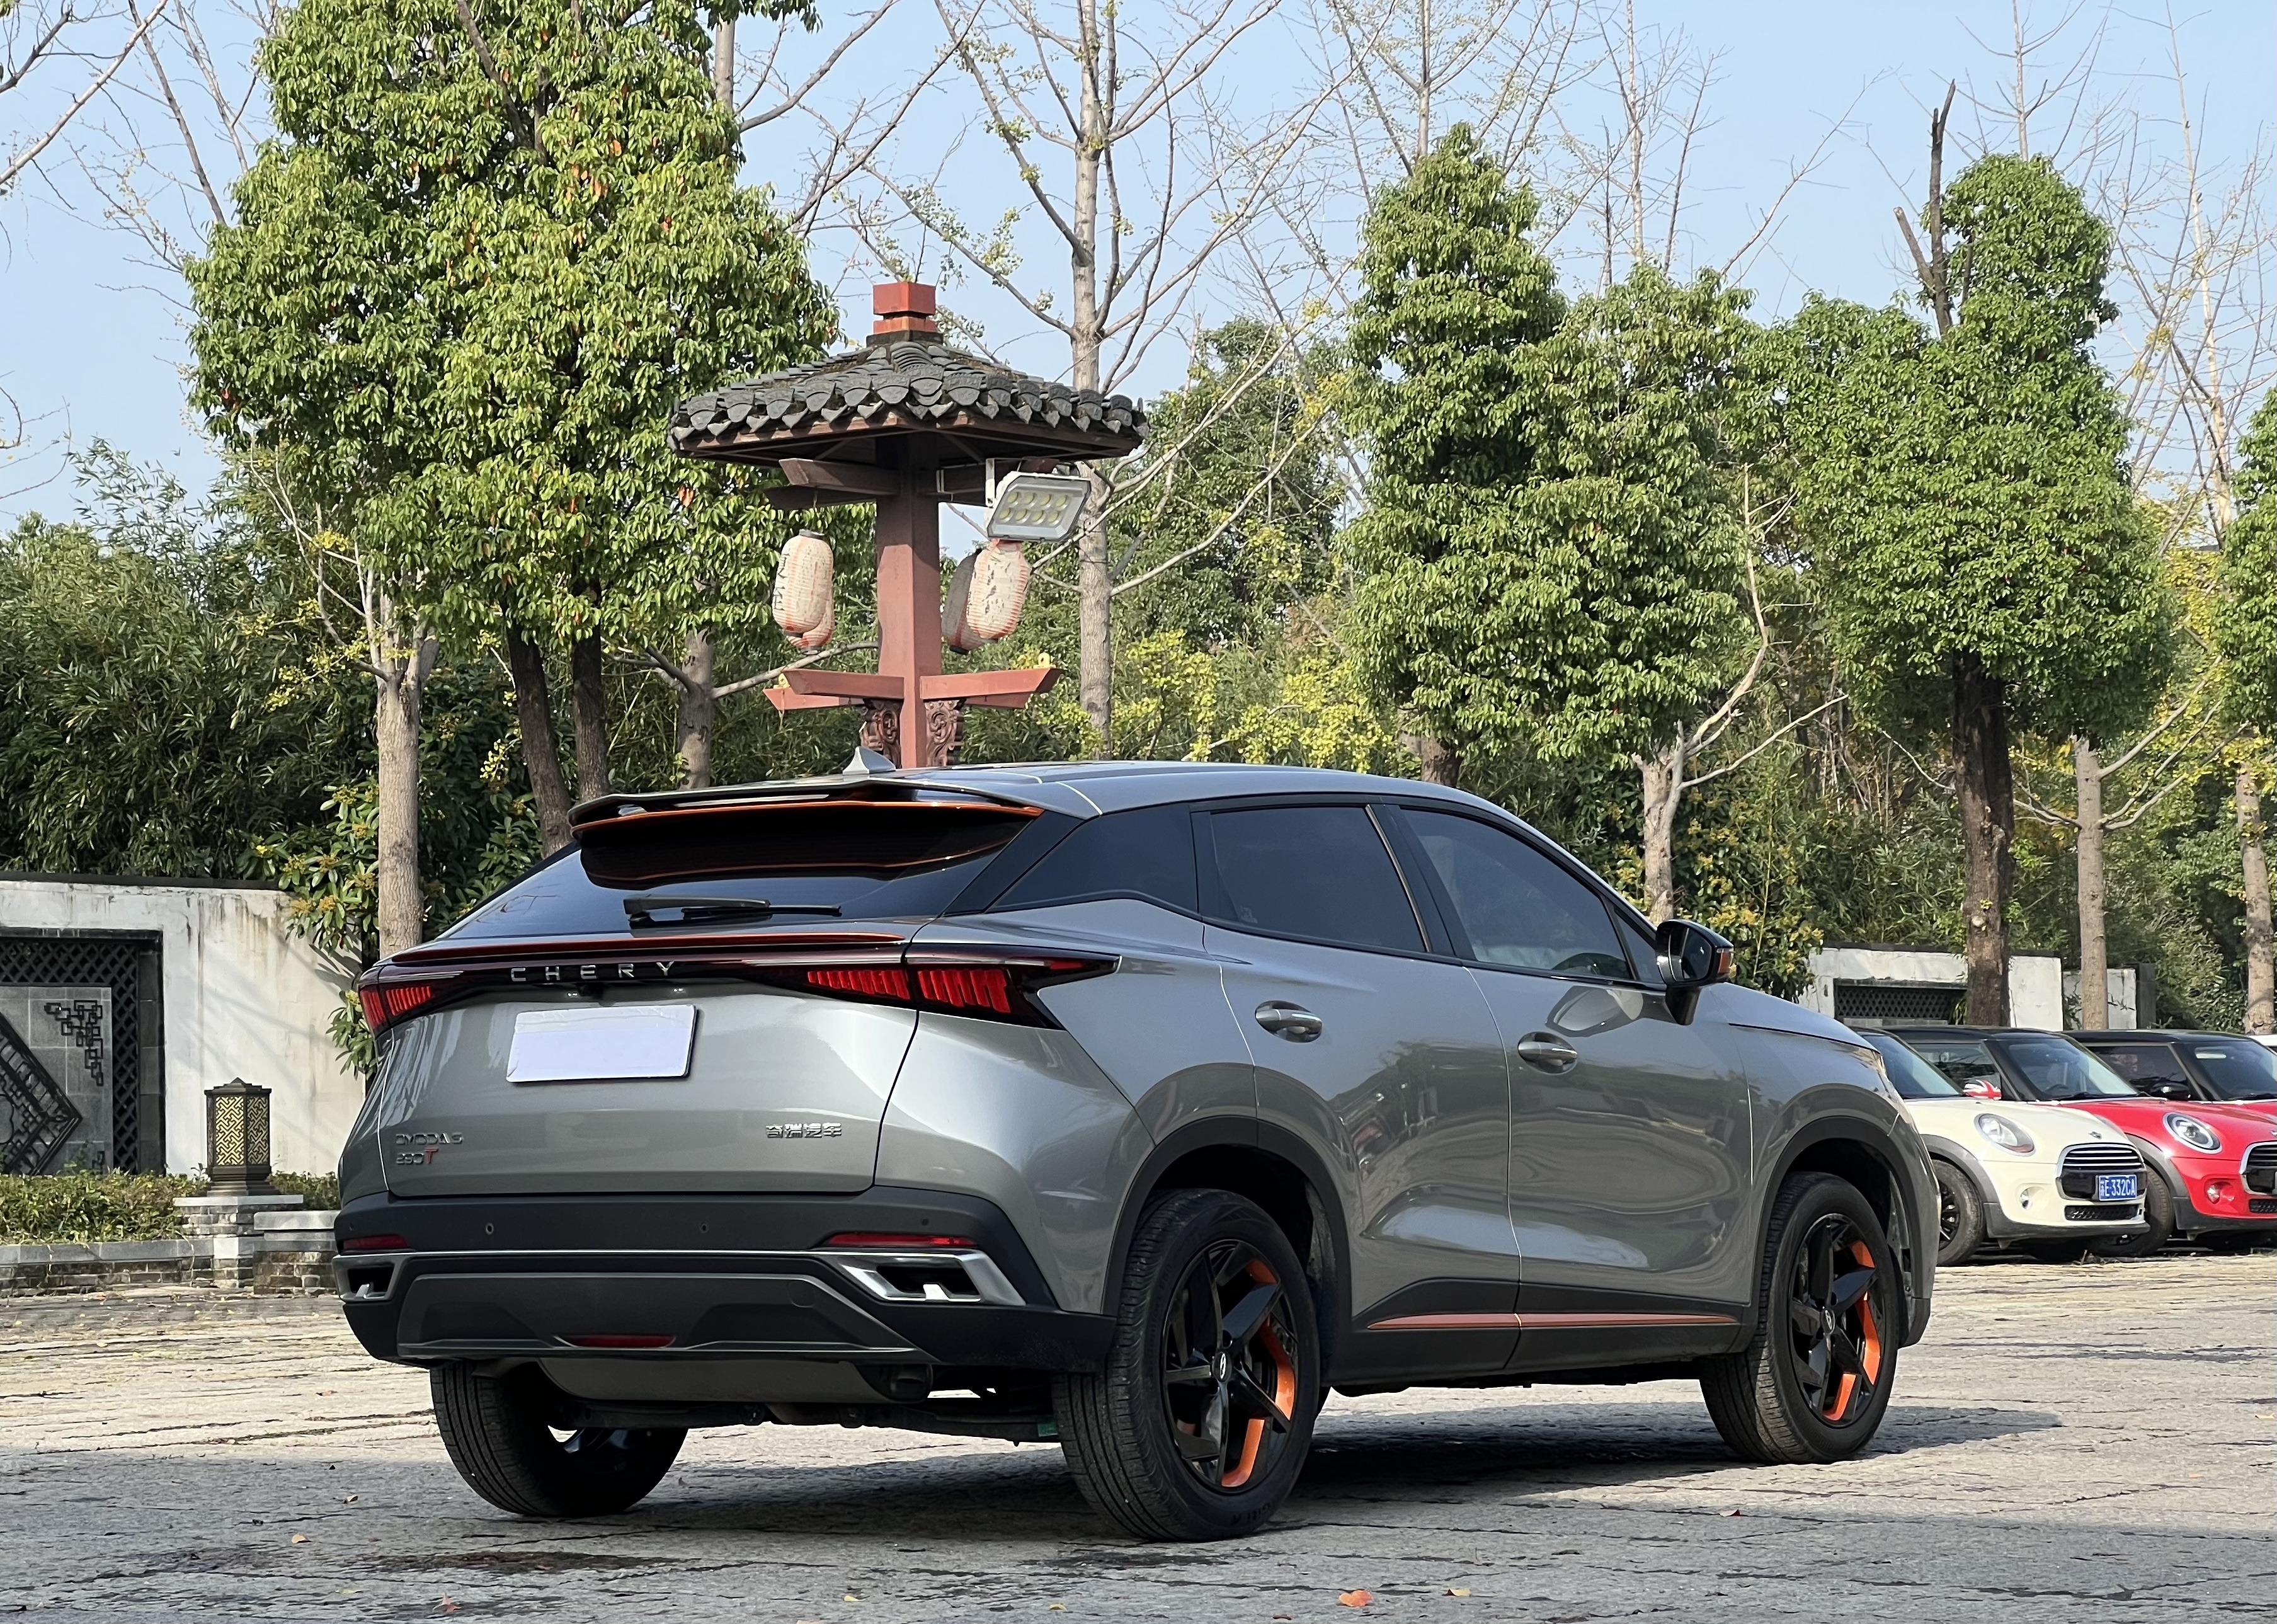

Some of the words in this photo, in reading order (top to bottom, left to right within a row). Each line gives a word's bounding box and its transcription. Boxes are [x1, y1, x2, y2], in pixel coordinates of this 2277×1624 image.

[511, 961, 674, 981] CHERY
[765, 1123, 842, 1138] 奇瑞汽车
